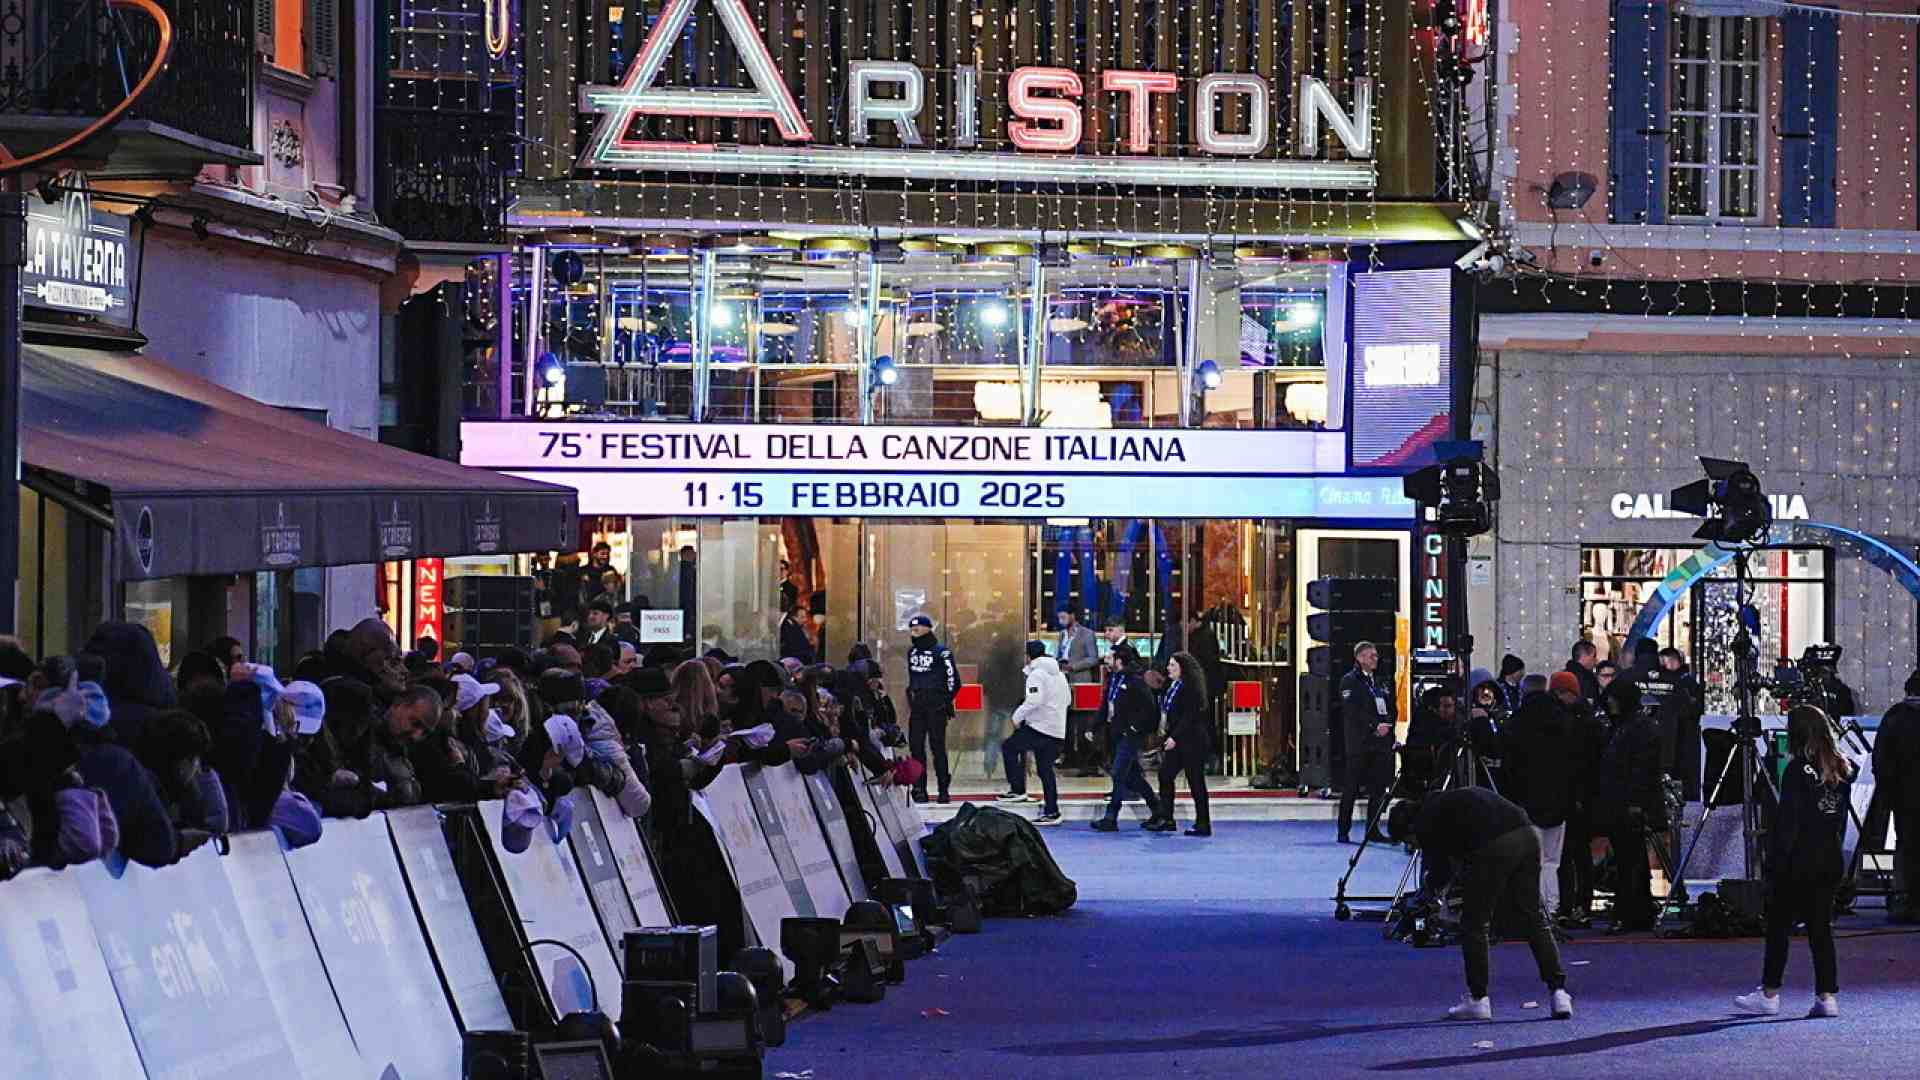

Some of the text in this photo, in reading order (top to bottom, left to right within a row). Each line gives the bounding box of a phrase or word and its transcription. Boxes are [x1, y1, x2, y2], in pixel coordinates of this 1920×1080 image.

[578, 0, 1374, 160] ARISTON
[51, 231, 125, 287] TAVERNA
[601, 433, 751, 459] FESTIVAL
[767, 434, 868, 460] DELLA
[882, 434, 1031, 461] CANZONE
[1045, 436, 1186, 462] ITALIANA
[792, 482, 959, 508] FEBBRAIO
[979, 481, 1065, 508] 2025
